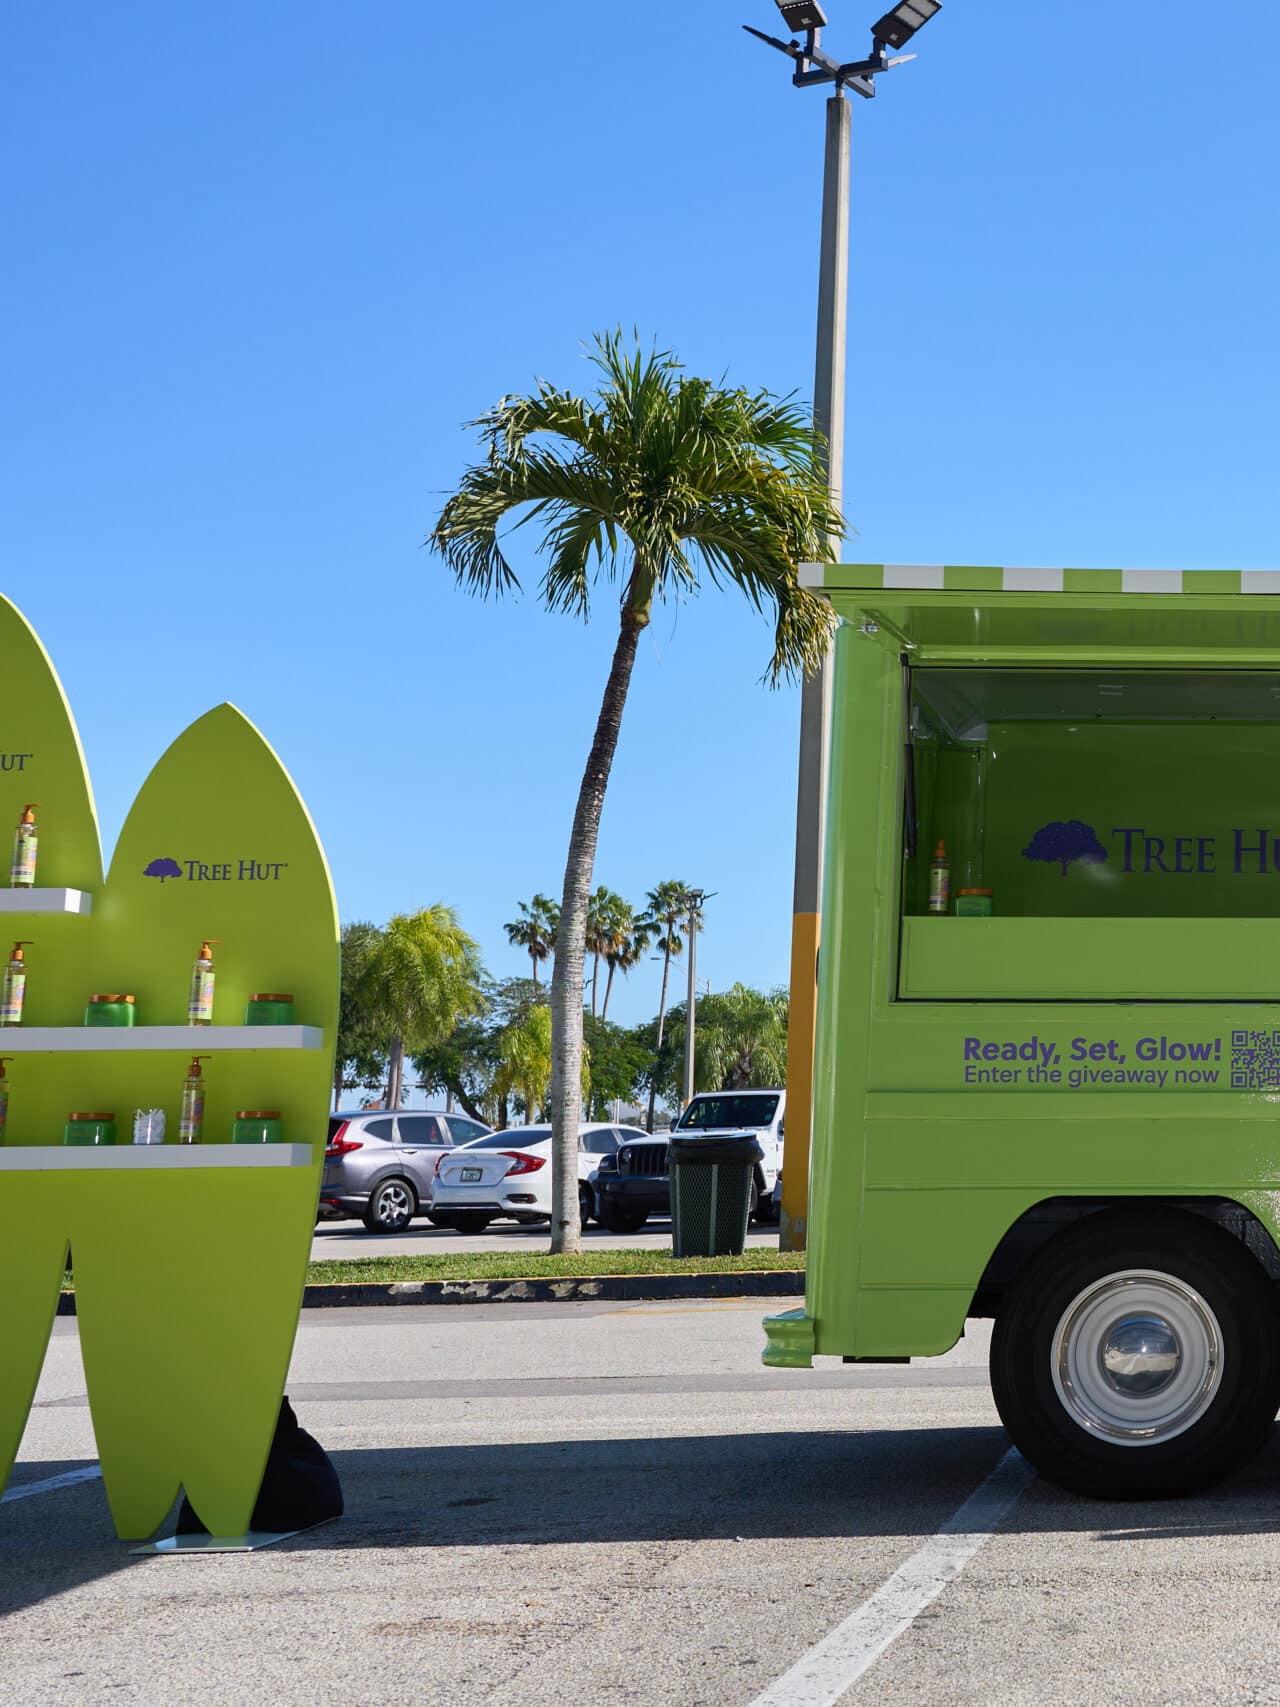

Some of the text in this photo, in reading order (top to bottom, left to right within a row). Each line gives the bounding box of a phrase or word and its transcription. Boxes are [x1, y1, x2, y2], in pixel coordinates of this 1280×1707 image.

[0, 753, 29, 771] UT
[1112, 828, 1217, 874] TREE
[184, 859, 282, 881] TREE HUT
[963, 1036, 1222, 1067] Ready, Set, Glow!
[964, 1064, 1220, 1088] Enter the giveaway now
